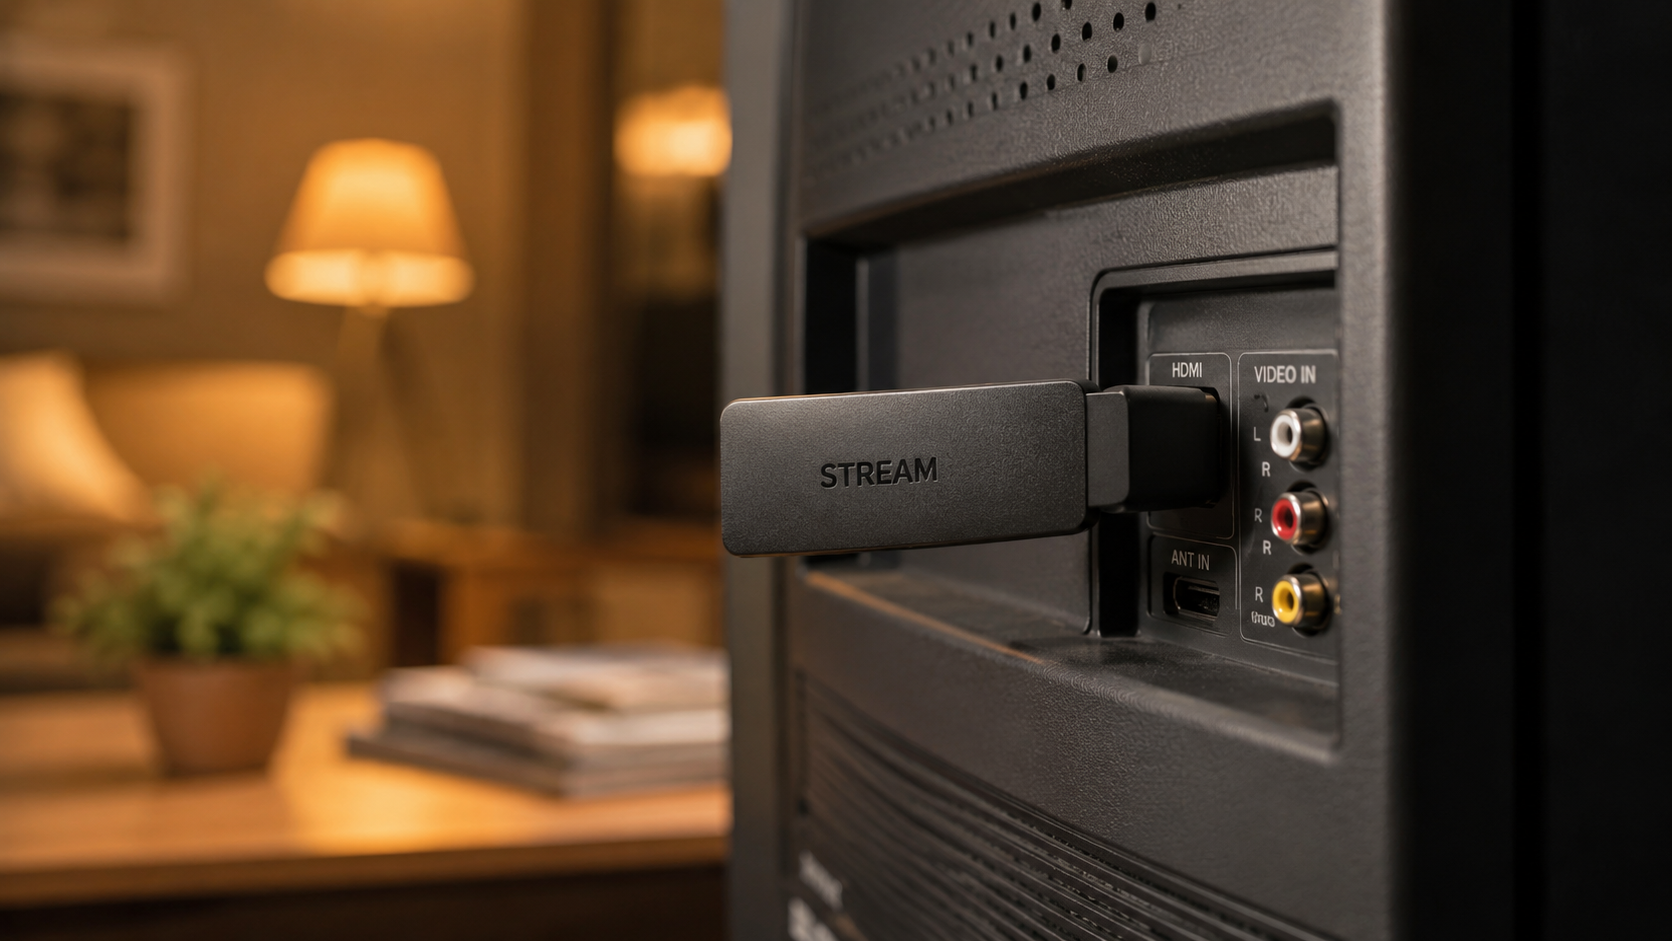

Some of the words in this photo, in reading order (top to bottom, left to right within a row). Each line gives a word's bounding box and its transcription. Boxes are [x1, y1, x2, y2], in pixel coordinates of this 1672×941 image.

[1172, 362, 1202, 378] HDMI
[1254, 365, 1297, 383] VIDEO
[1301, 365, 1316, 384] IN
[1253, 426, 1261, 441] L
[820, 456, 938, 489] STREAM
[1261, 461, 1271, 477] R
[1254, 508, 1262, 523] R
[1262, 540, 1272, 555] R
[1171, 549, 1194, 568] ANT
[1198, 553, 1210, 571] IN
[1255, 586, 1264, 603] R
